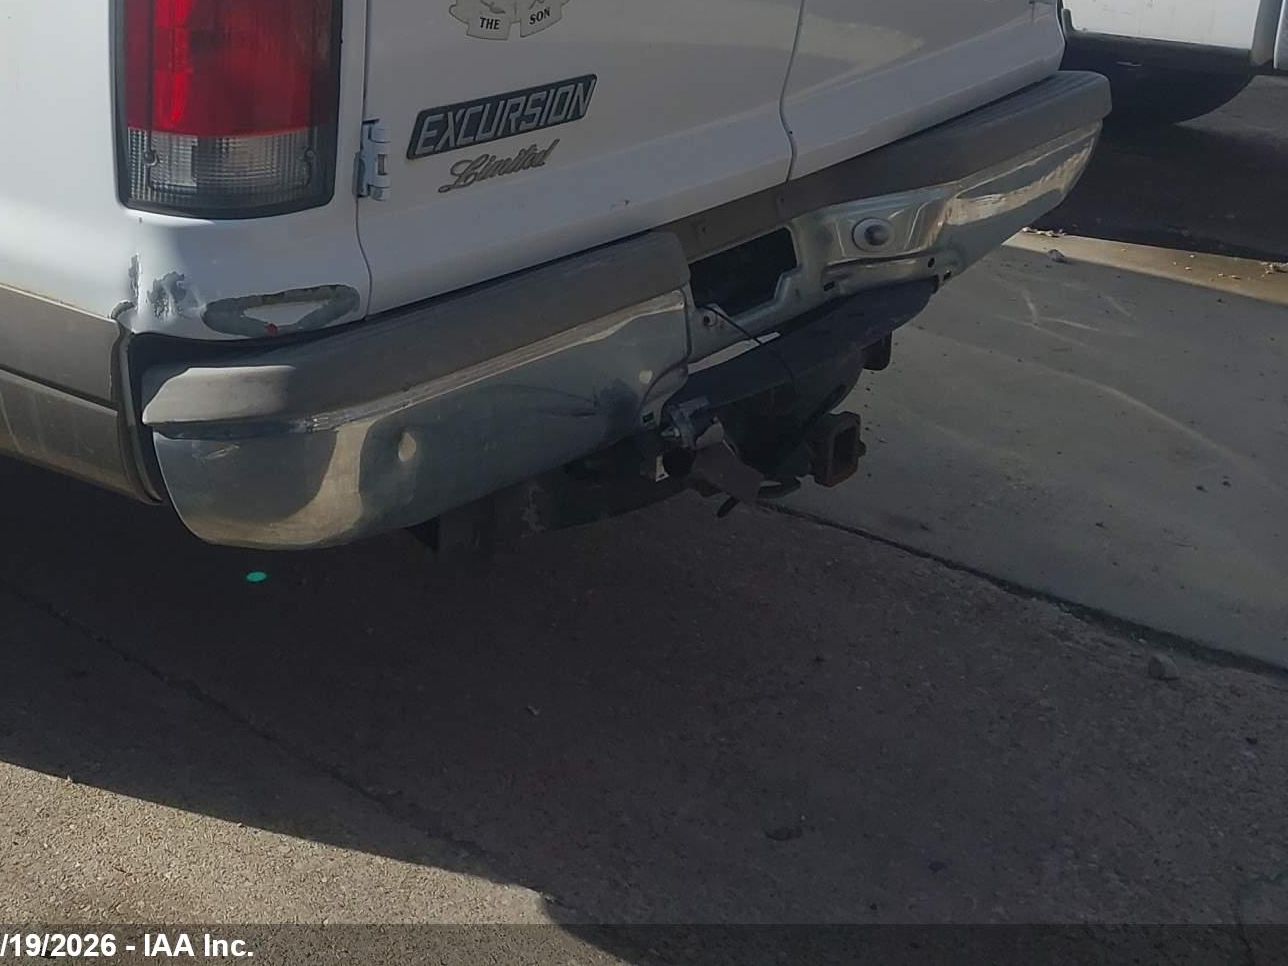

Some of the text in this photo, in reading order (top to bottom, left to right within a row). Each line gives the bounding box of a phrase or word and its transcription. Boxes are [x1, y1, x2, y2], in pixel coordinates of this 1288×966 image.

[479, 7, 551, 30] THE SON
[415, 81, 595, 154] EXCURSION
[438, 139, 560, 193] Limited
